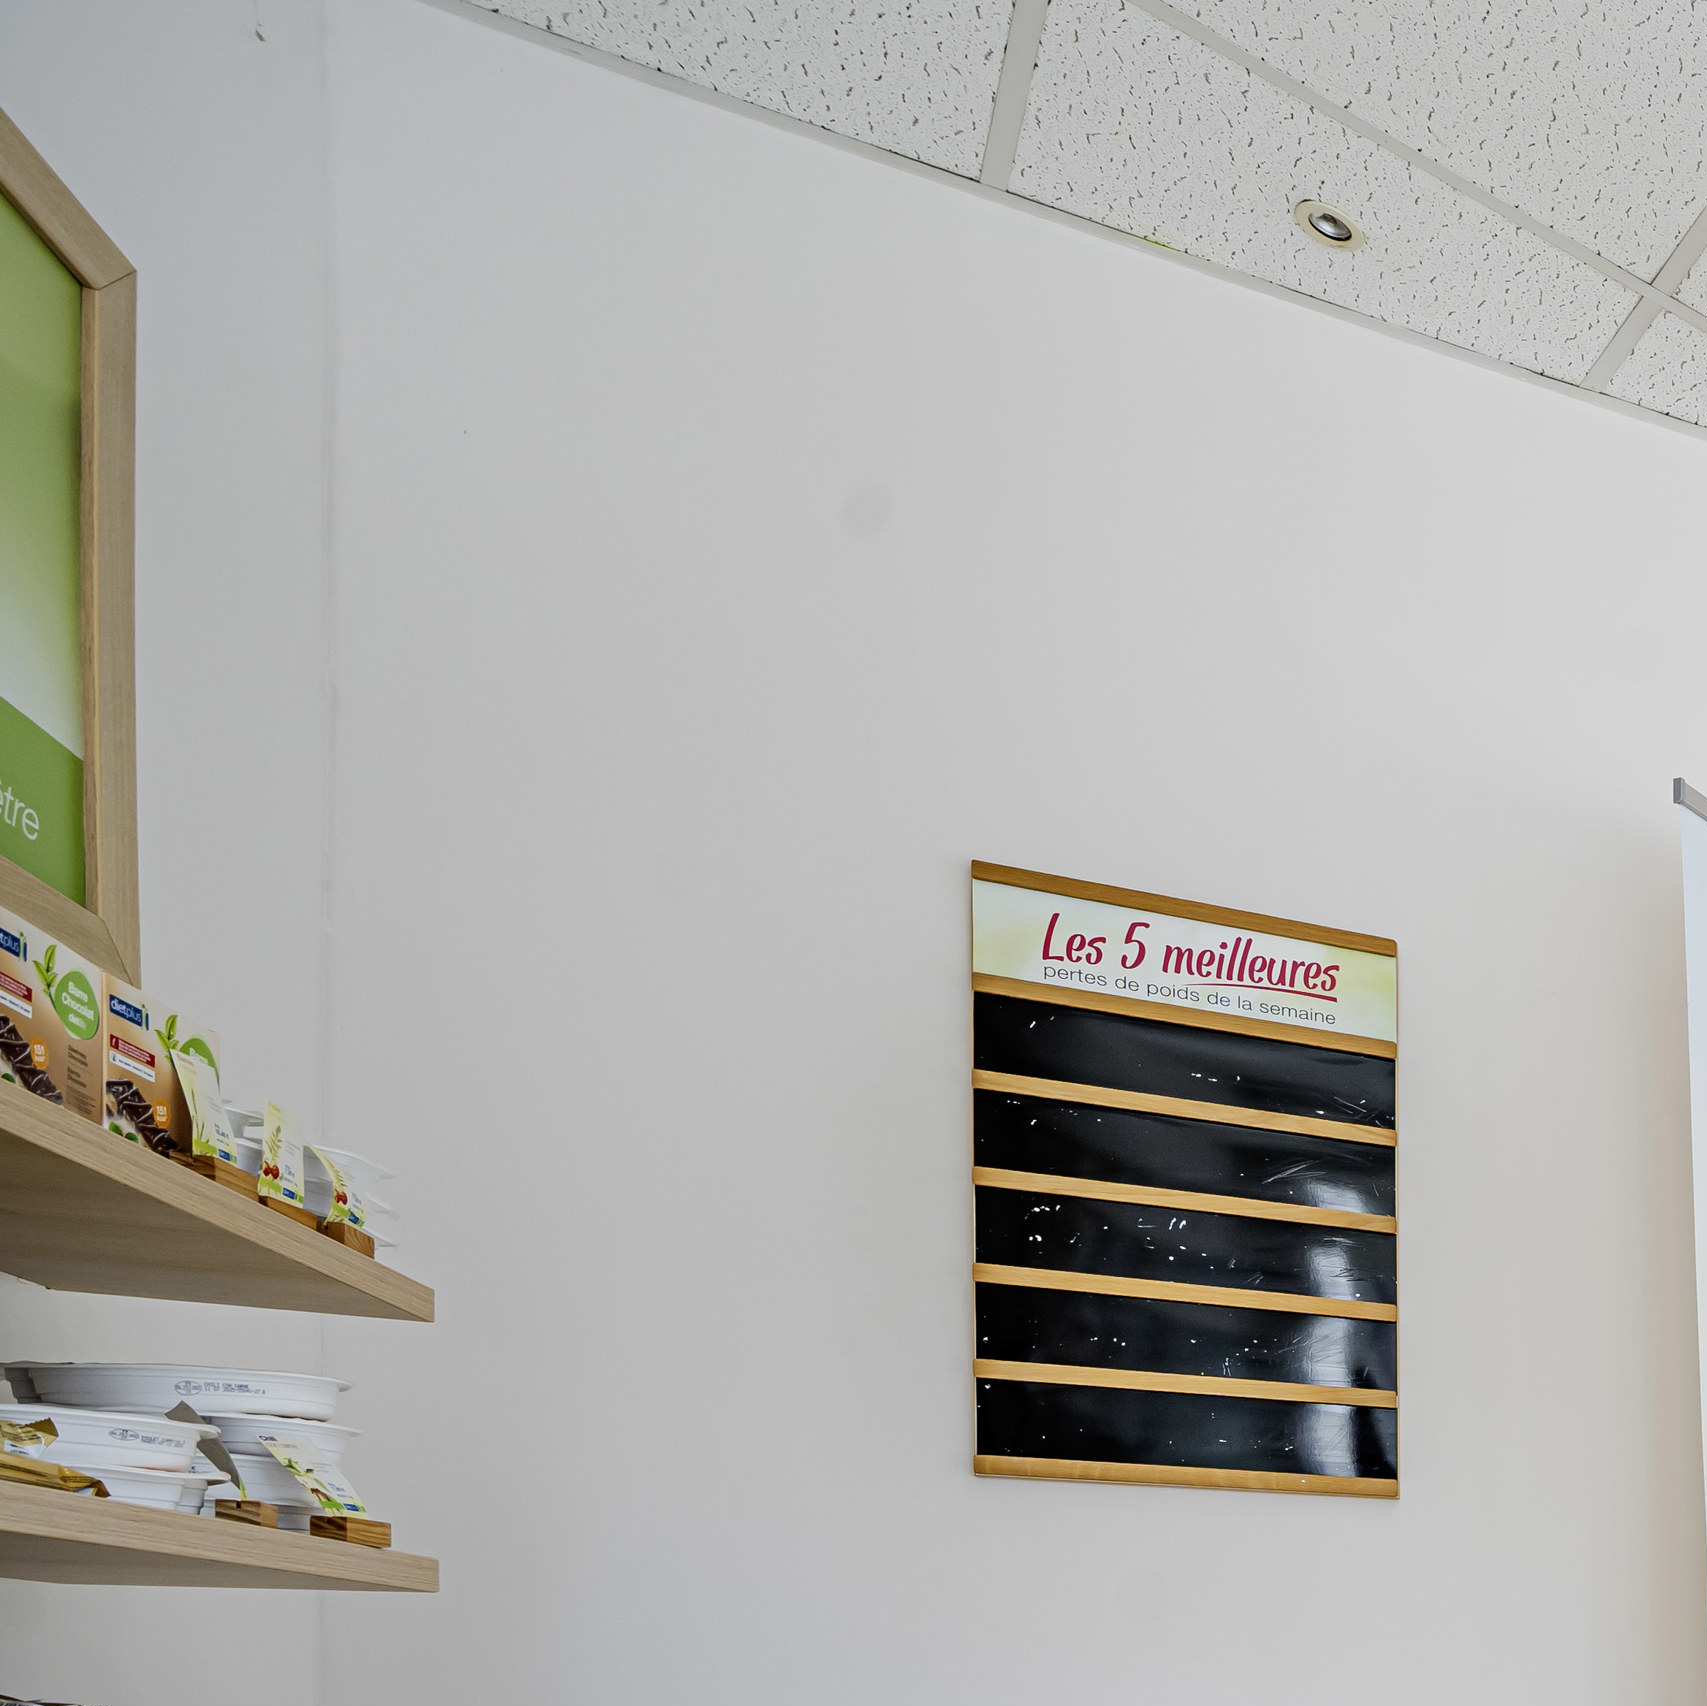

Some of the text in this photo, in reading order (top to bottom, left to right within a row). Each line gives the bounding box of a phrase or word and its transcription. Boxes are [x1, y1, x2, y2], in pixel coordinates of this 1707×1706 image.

[0, 781, 40, 841] tre
[1042, 912, 1340, 992] Les 5 meilleures
[111, 997, 142, 1024] dietplus
[1043, 965, 1337, 1026] pertes de poids de la semaine
